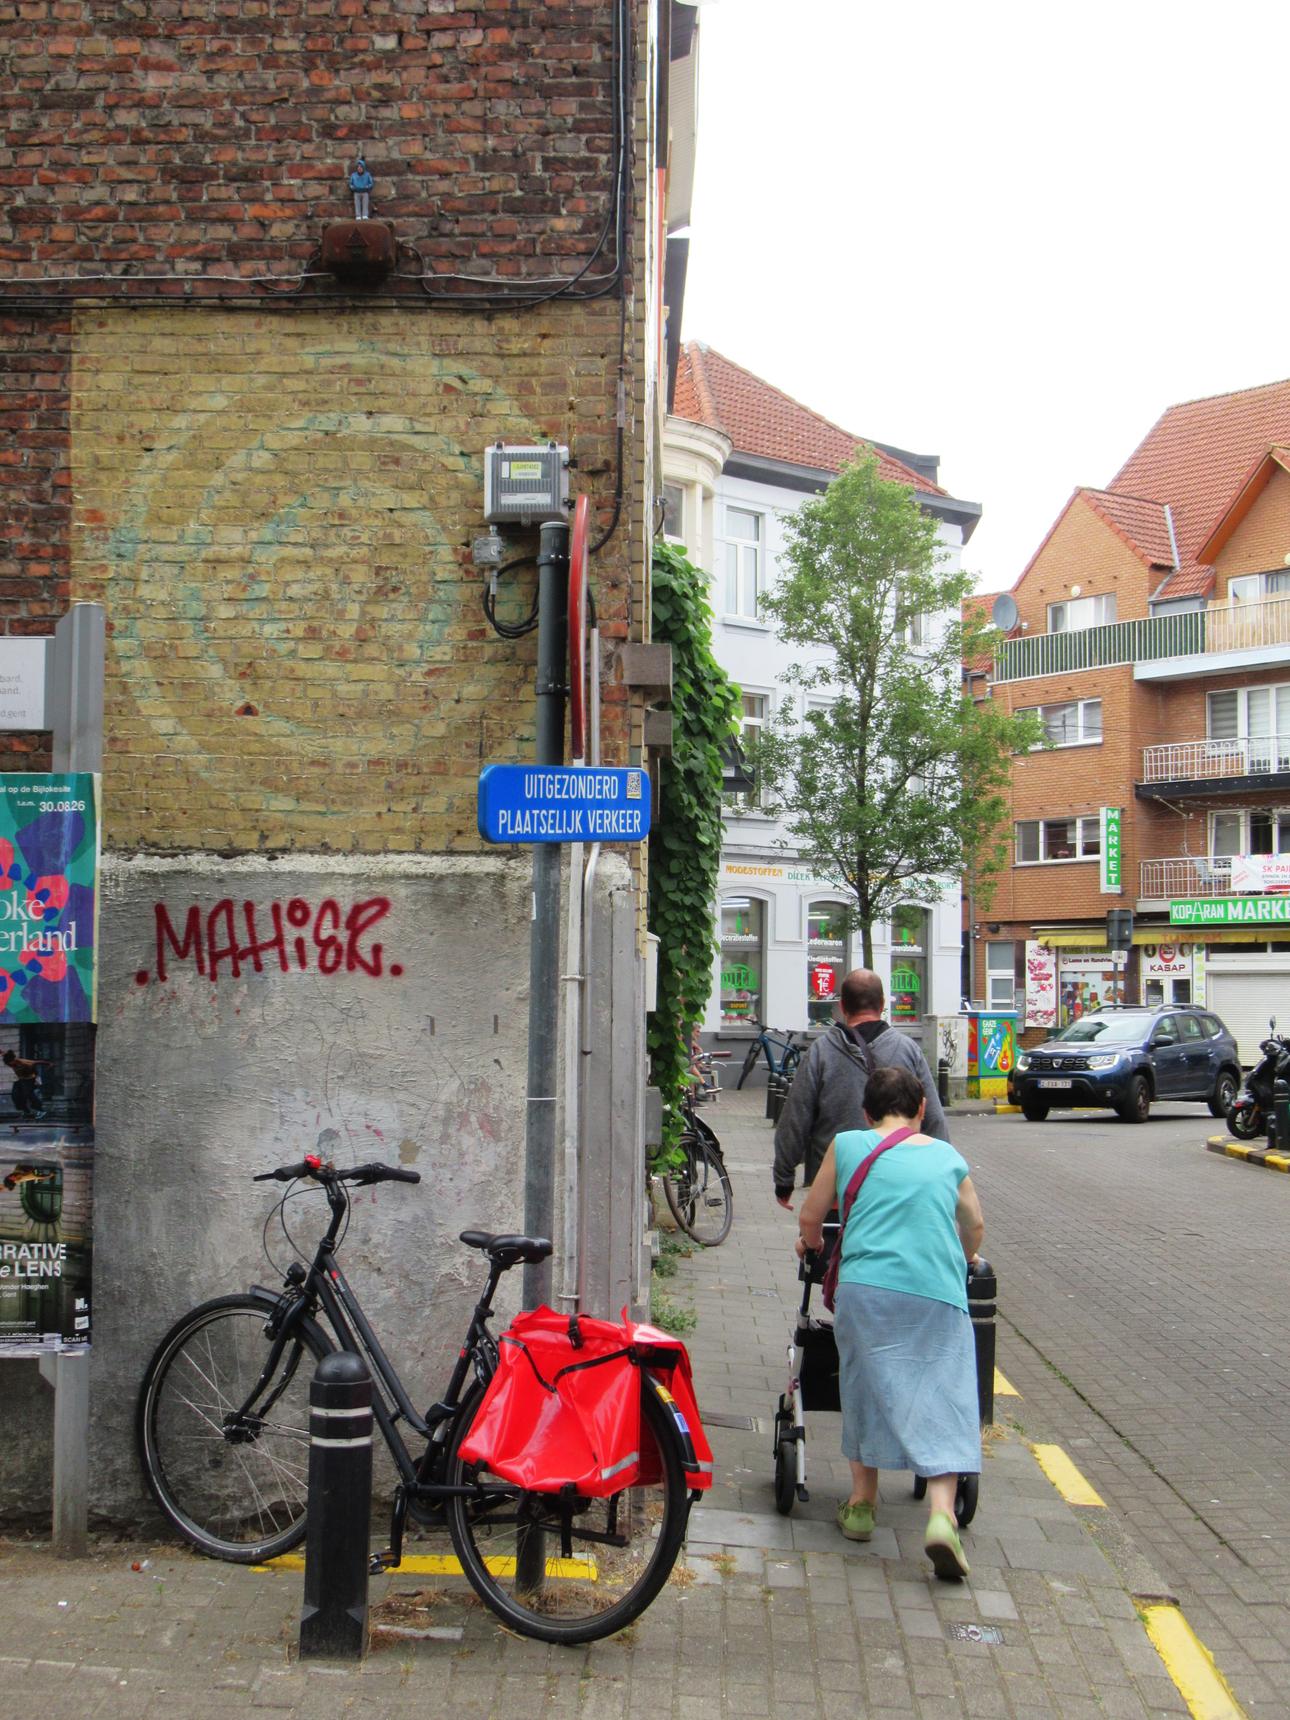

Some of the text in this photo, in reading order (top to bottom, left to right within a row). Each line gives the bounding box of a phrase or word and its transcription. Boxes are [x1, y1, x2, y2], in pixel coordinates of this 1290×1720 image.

[525, 773, 619, 799] UITGEZONDERD
[498, 809, 641, 835] PLAATSELIJK VERKEER
[1107, 810, 1119, 884] MARKET
[725, 864, 783, 877] MODESTOFFEN
[1172, 902, 1225, 921] KOPARAN
[1149, 964, 1186, 972] KASAP
[0, 1243, 67, 1259] RATIVE
[14, 1261, 61, 1277] LENS
